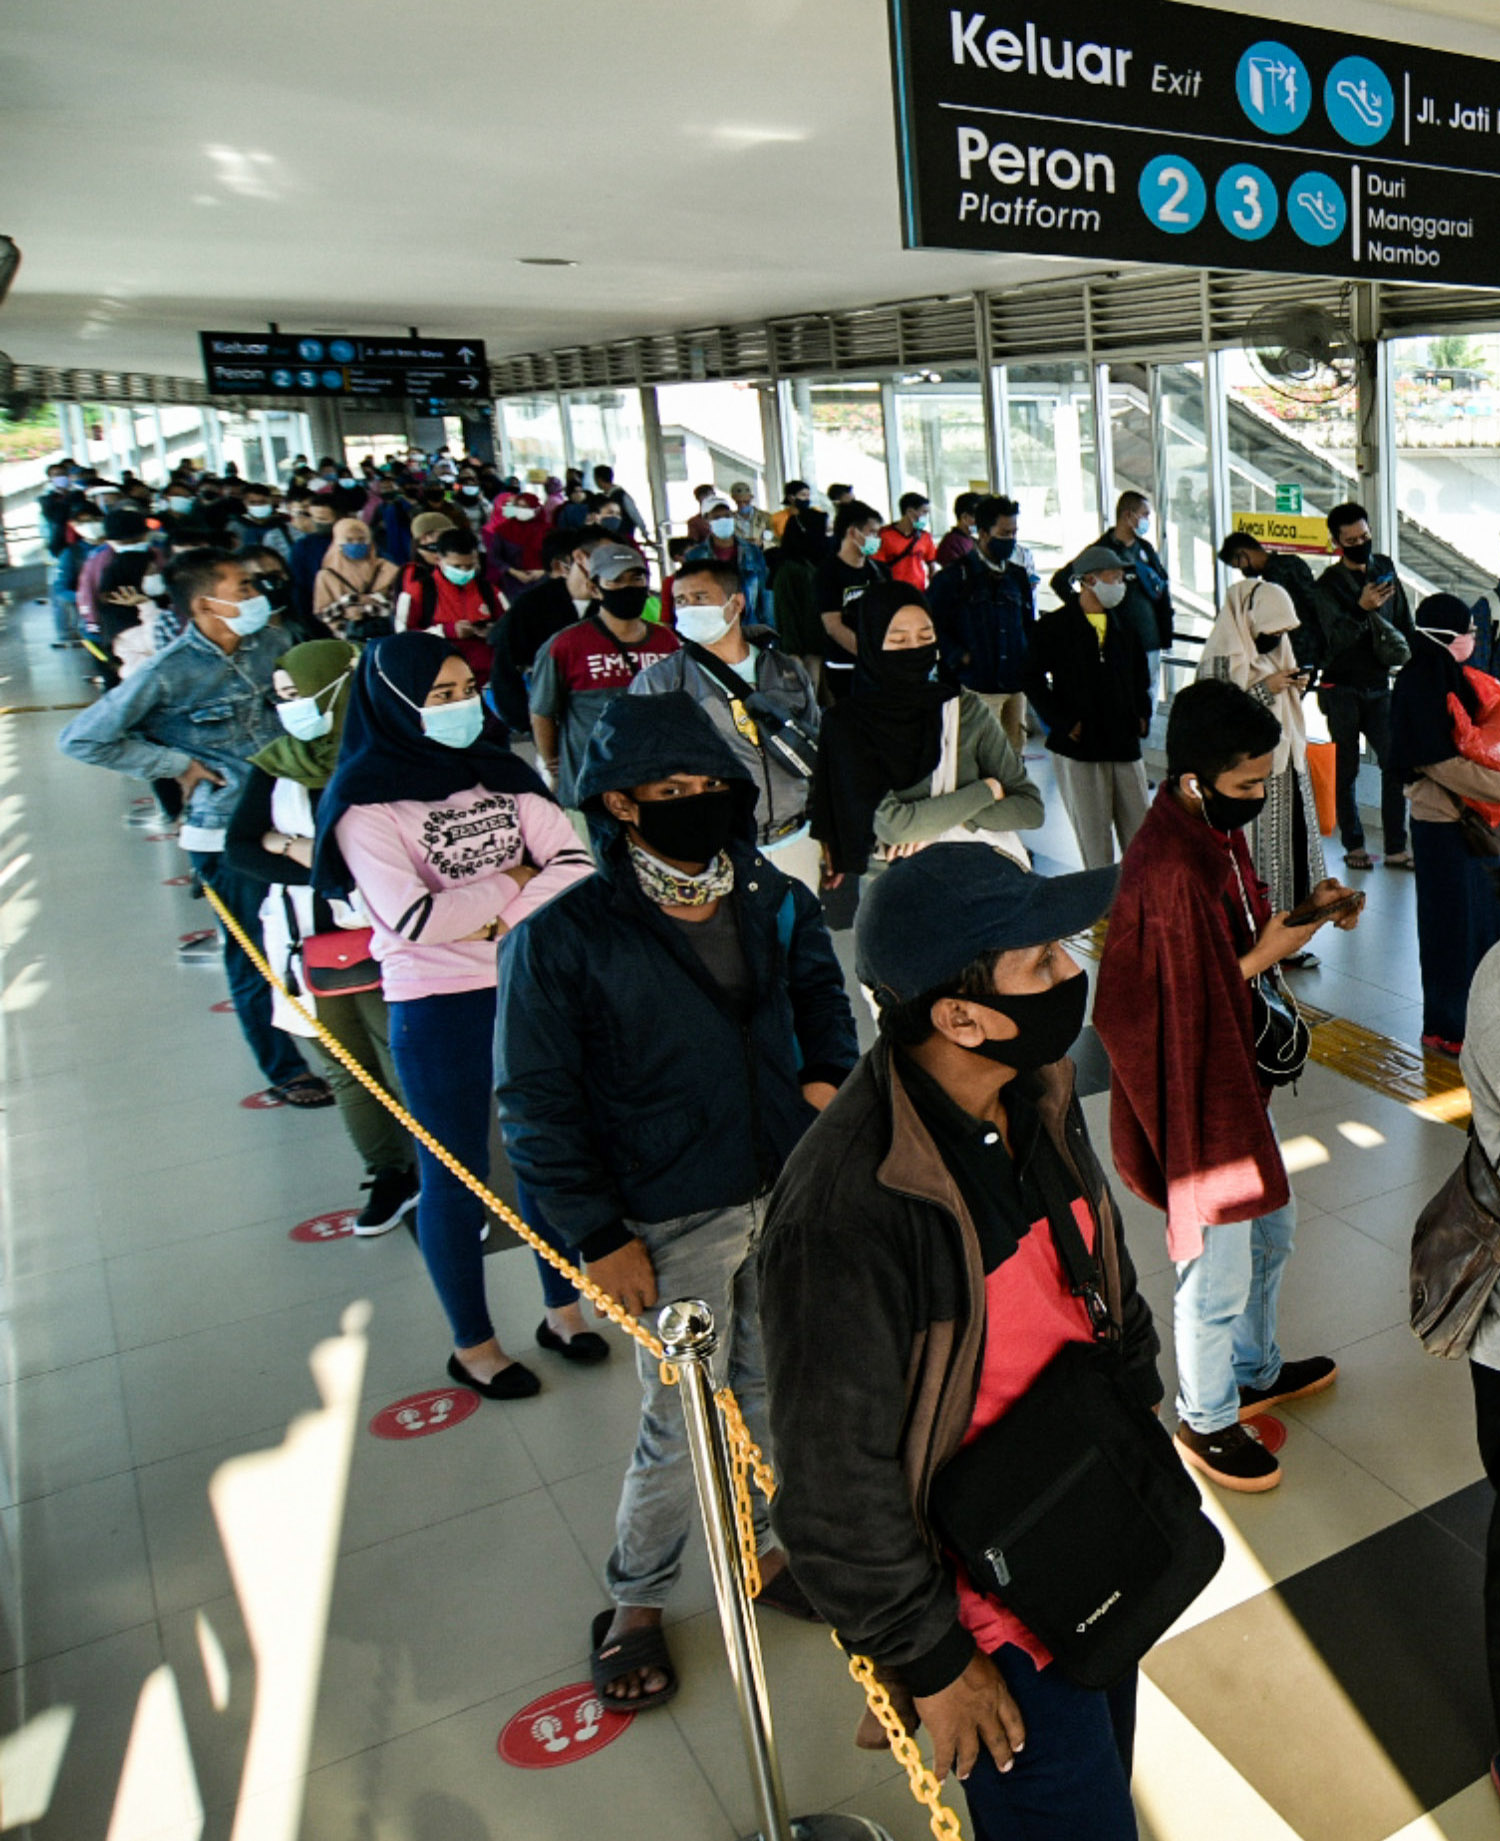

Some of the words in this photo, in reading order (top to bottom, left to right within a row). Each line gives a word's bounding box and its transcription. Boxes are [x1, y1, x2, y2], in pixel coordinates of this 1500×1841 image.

[950, 10, 1133, 87] Keluar
[1151, 64, 1202, 98] Exit
[1416, 97, 1440, 125] Jl.
[1449, 102, 1490, 132] Jati
[957, 126, 1116, 193] Peron
[1157, 167, 1191, 223] 2
[1232, 175, 1263, 230] 3
[1367, 174, 1406, 198] Duri
[958, 190, 1101, 231] Platform
[1367, 208, 1473, 239] Manggarai
[1368, 241, 1441, 267] Nambo
[276, 369, 289, 387] 2
[301, 371, 313, 388] 3
[1238, 518, 1264, 536] Awas
[1267, 520, 1297, 538] Kaca
